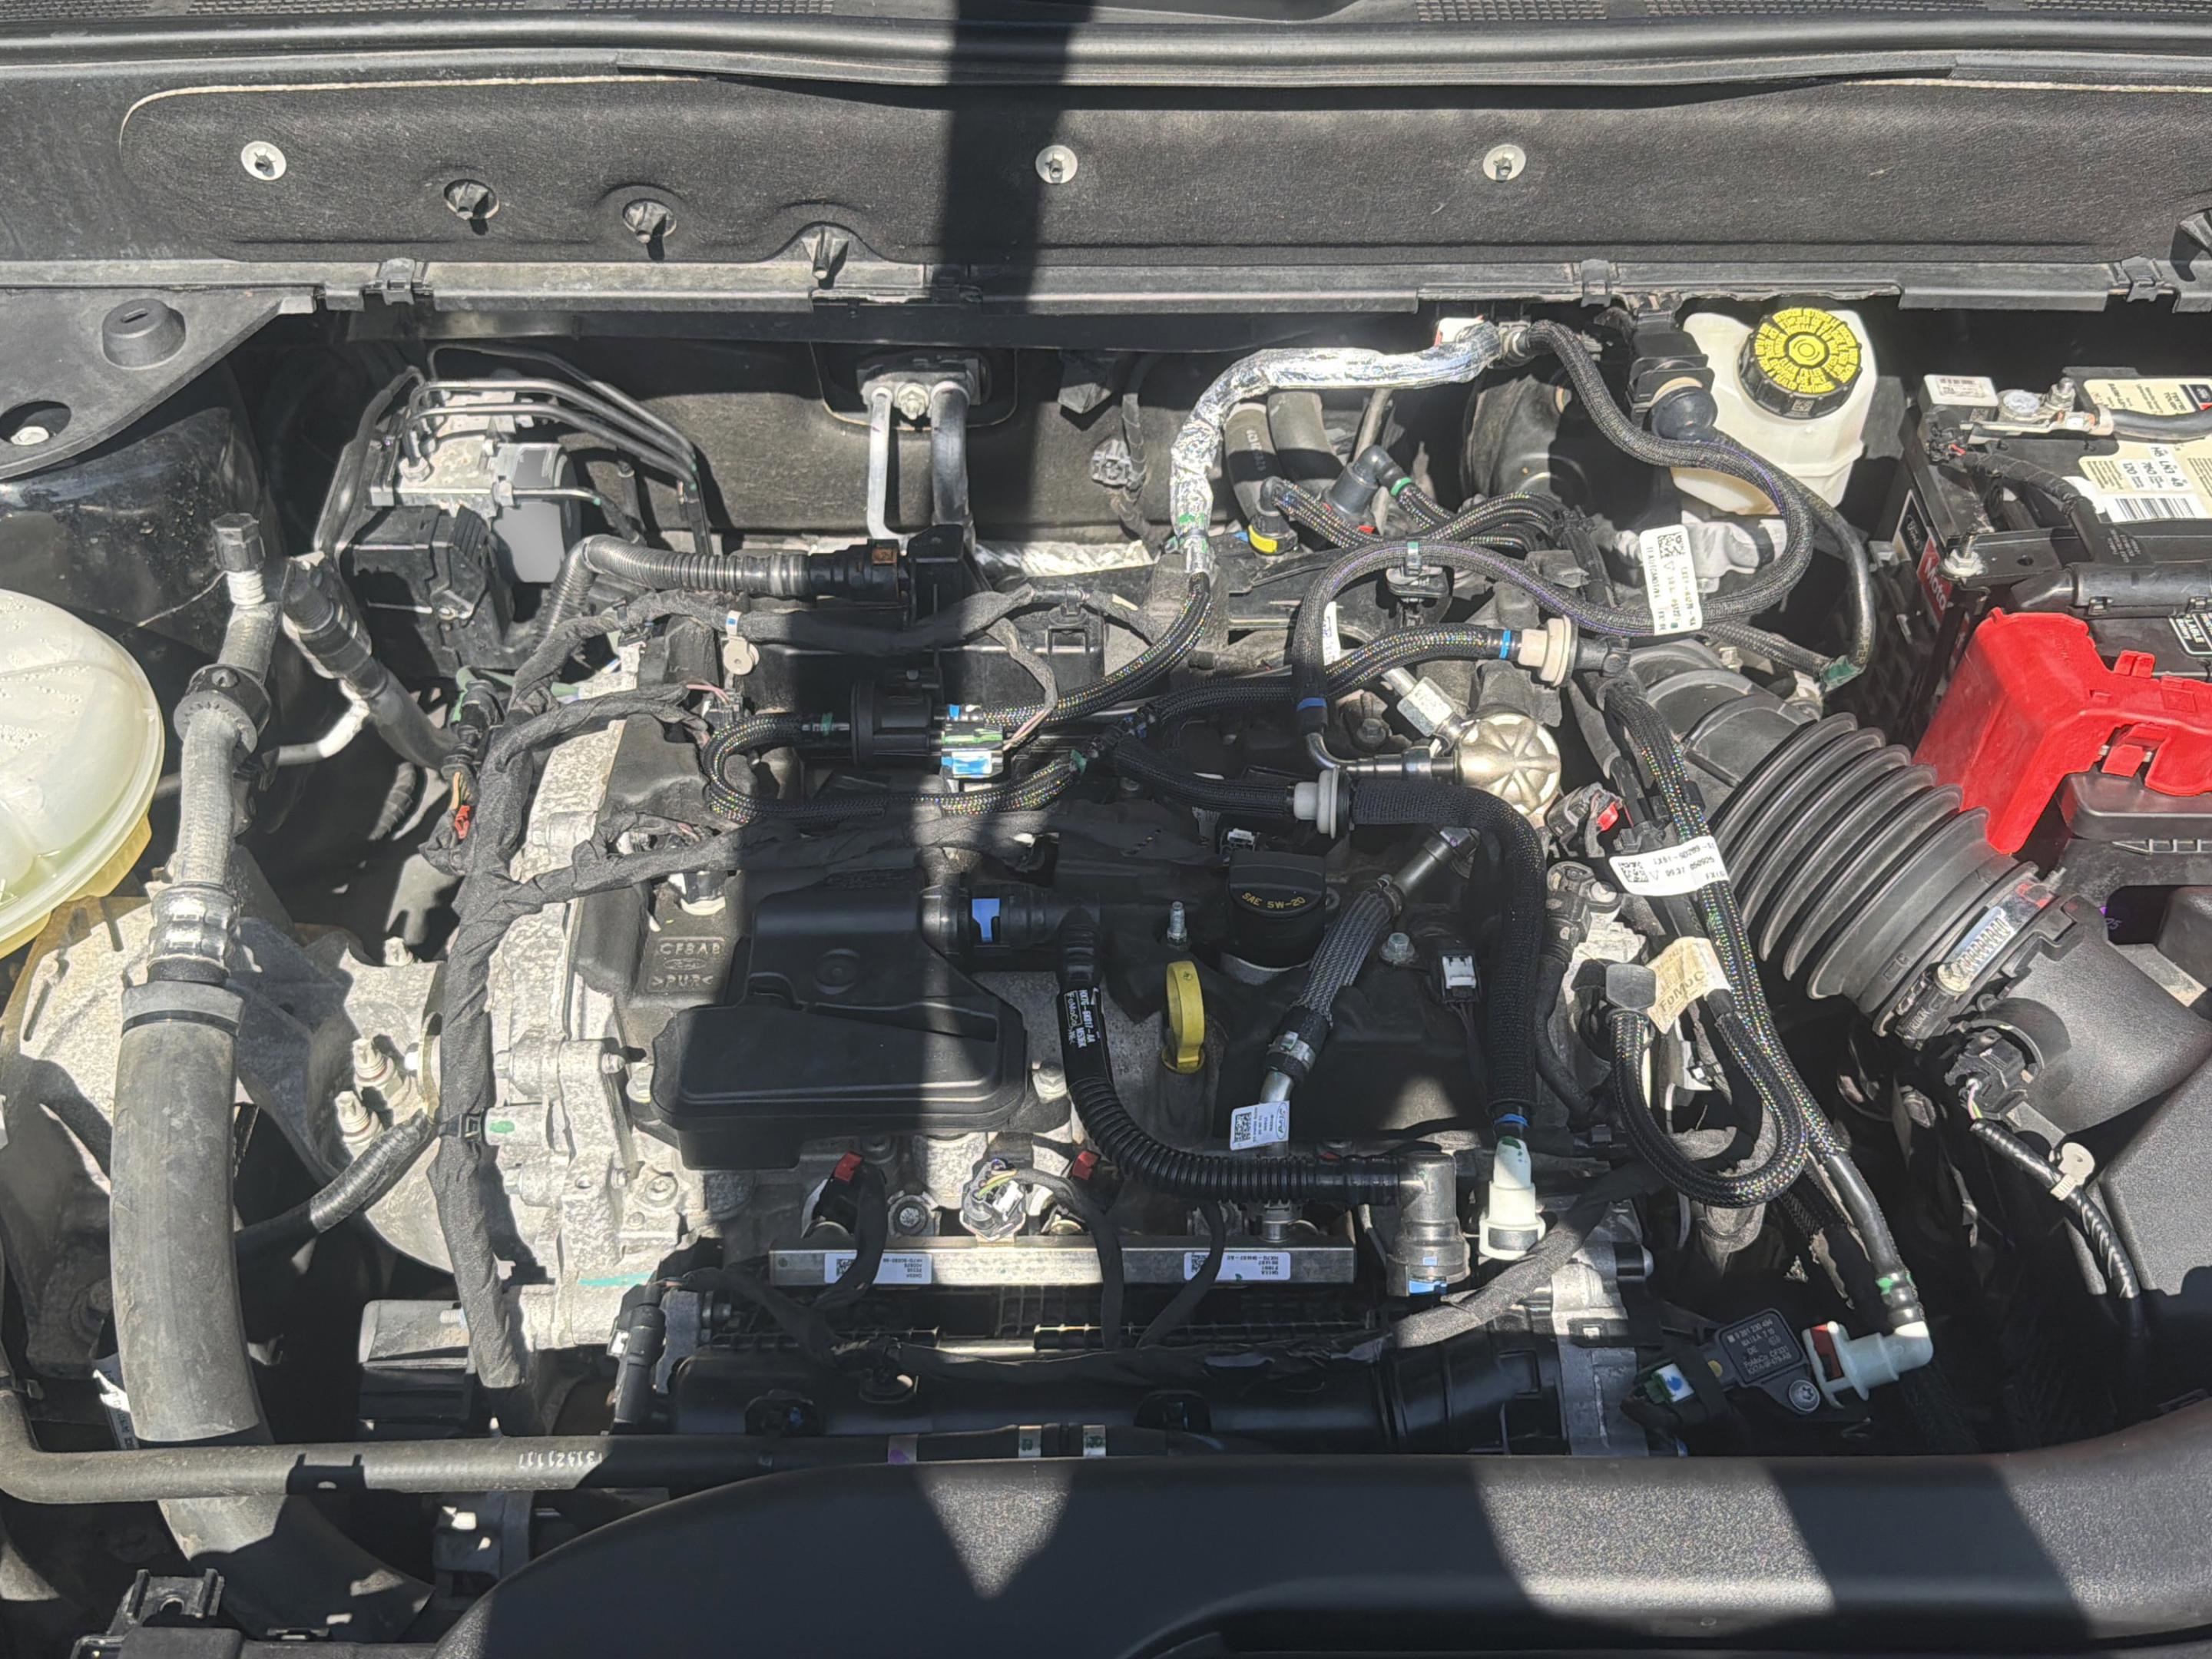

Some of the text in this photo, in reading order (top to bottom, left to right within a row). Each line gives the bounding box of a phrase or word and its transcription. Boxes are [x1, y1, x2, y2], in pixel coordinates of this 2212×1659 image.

[2158, 460, 2175, 475] LN3
[1925, 557, 1947, 611] Moto
[1242, 891, 1306, 909] SAE 5W-20
[1067, 992, 1079, 1026] FoMoCo
